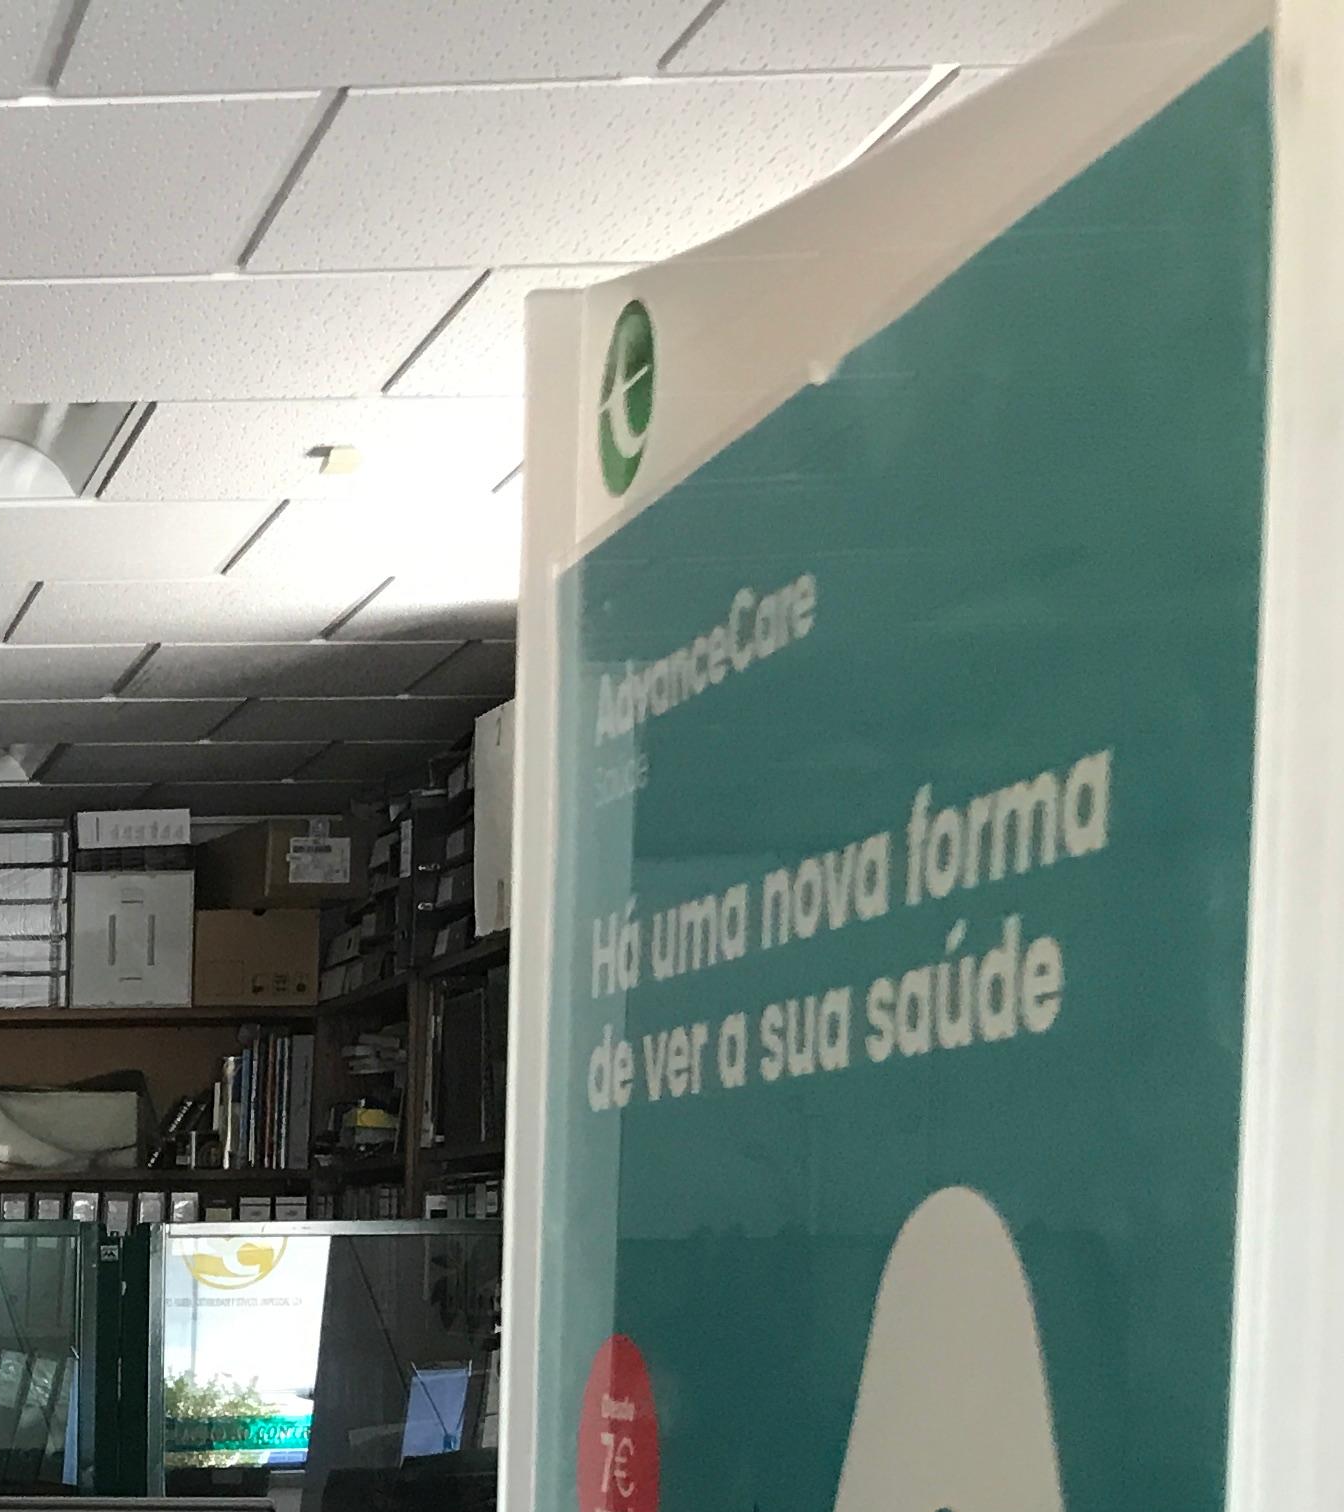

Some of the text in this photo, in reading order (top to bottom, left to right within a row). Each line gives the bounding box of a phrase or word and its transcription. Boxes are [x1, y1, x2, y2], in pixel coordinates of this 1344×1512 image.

[595, 572, 817, 739] AdvanceCare
[590, 747, 1112, 999] Há uma nova forma
[587, 912, 1065, 1113] de ver a sua saúde
[600, 1432, 635, 1498] 7€
